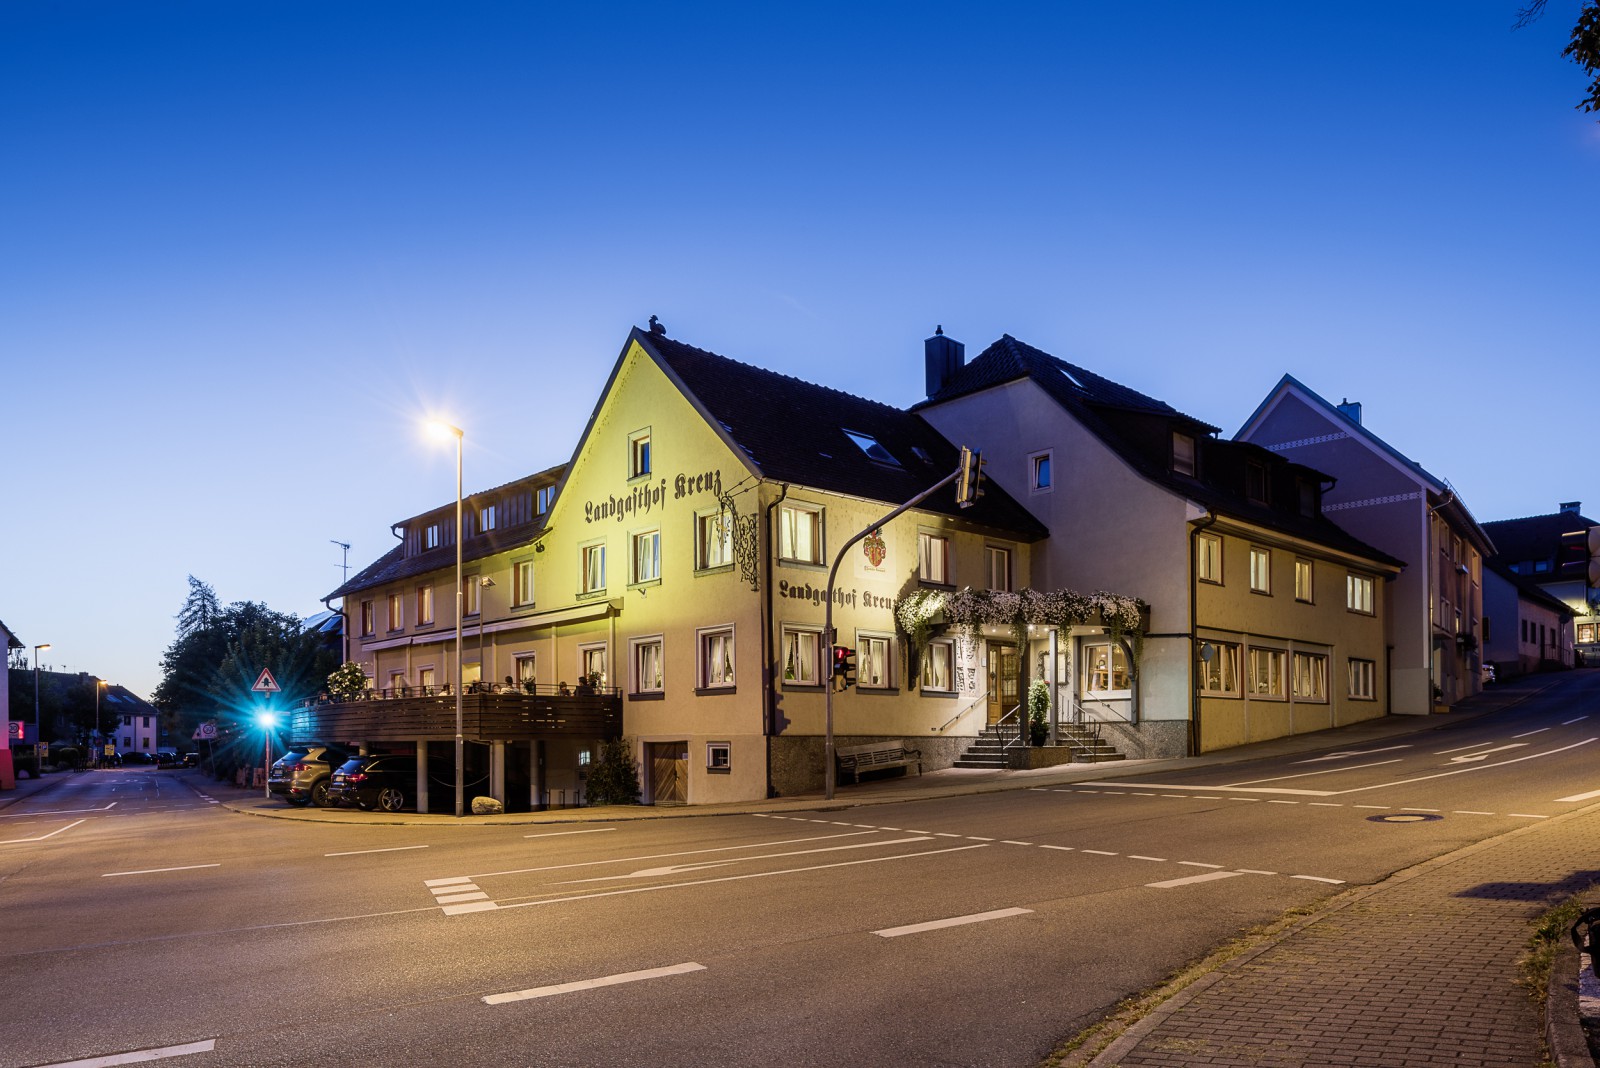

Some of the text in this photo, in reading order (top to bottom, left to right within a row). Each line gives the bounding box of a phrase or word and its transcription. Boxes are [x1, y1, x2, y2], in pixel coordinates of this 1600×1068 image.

[585, 469, 723, 524] Landgasthof Kreuz
[779, 579, 858, 611] Landgathof
